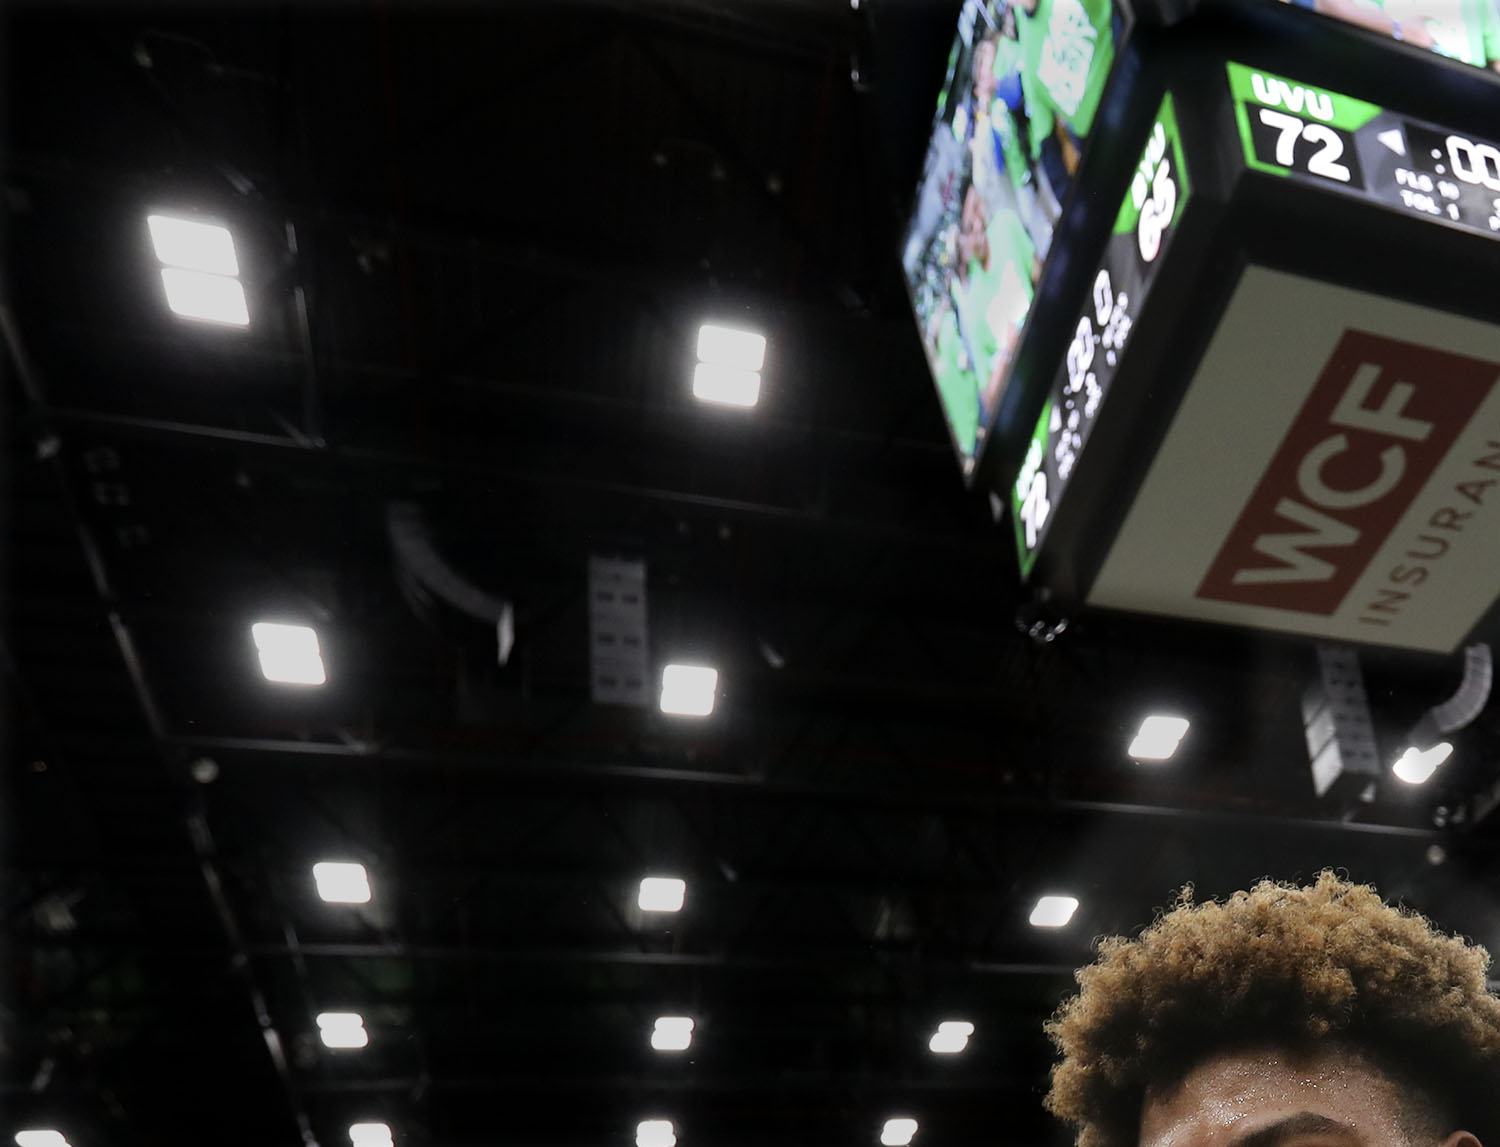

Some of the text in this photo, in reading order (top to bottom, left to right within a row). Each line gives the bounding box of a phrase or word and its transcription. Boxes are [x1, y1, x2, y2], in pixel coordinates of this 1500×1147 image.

[1251, 73, 1334, 121] UVU
[1259, 108, 1351, 182] 72
[1233, 362, 1434, 586] WCF
